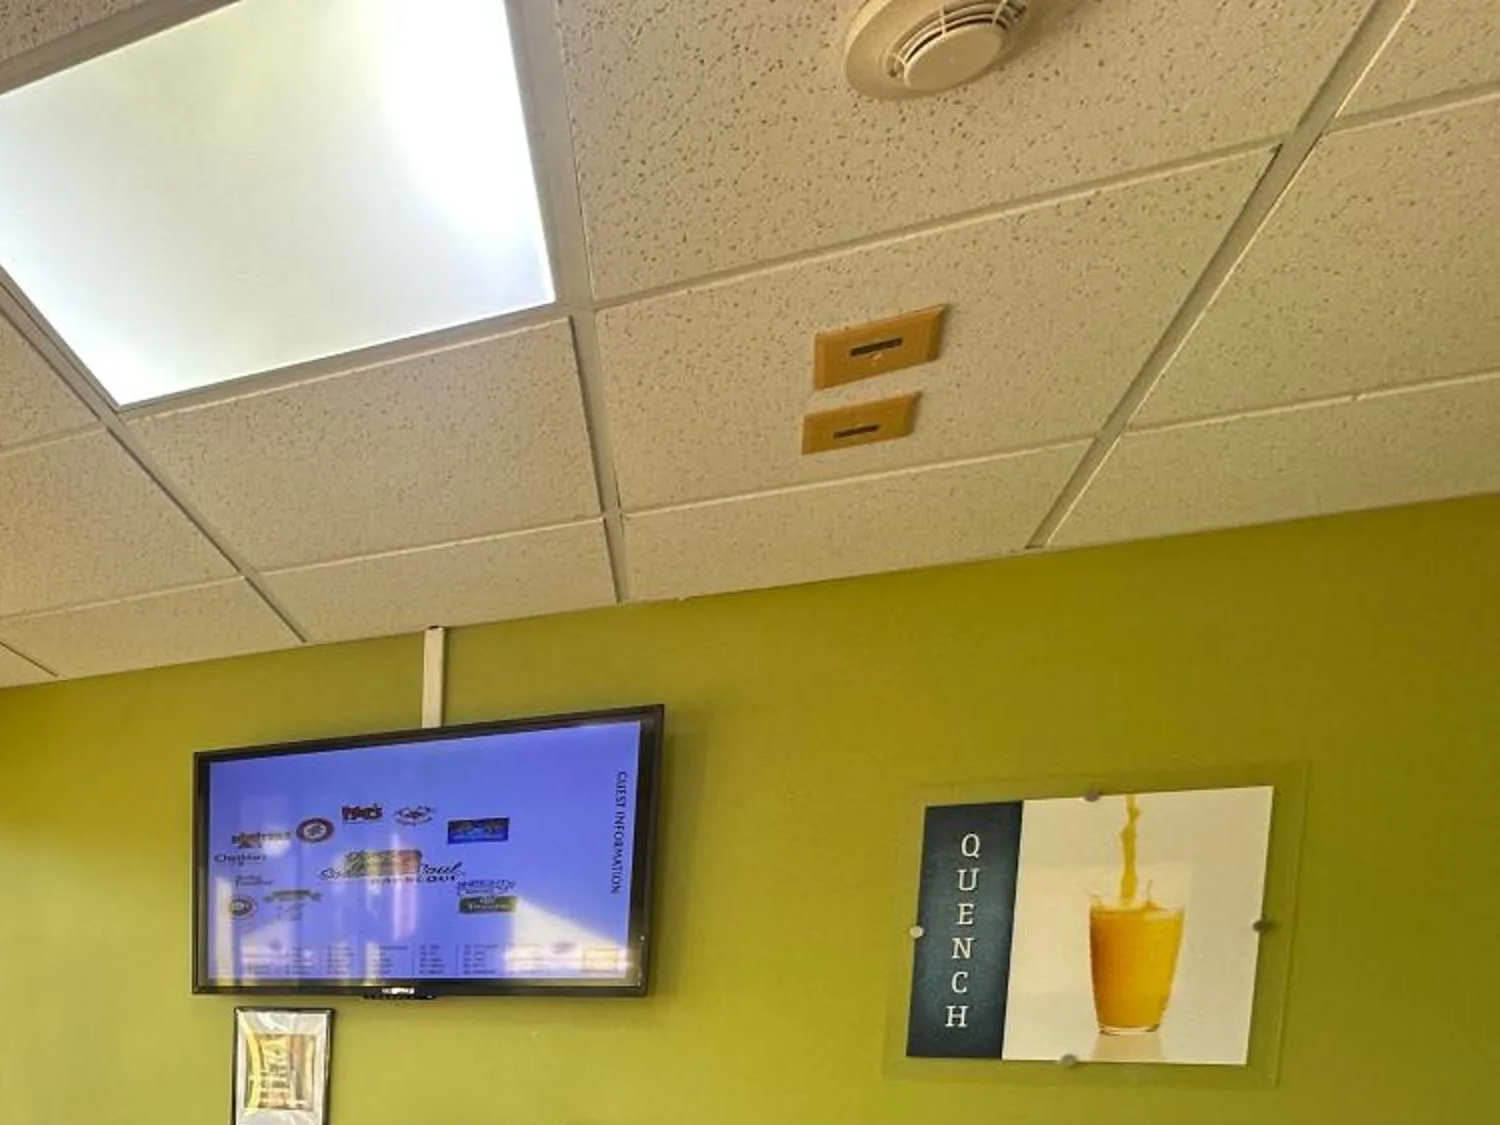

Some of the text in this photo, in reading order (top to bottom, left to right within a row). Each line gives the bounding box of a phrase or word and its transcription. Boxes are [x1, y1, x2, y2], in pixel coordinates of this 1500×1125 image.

[610, 770, 628, 894] GUEST INFORMATION
[944, 832, 982, 1028] QUENCH
